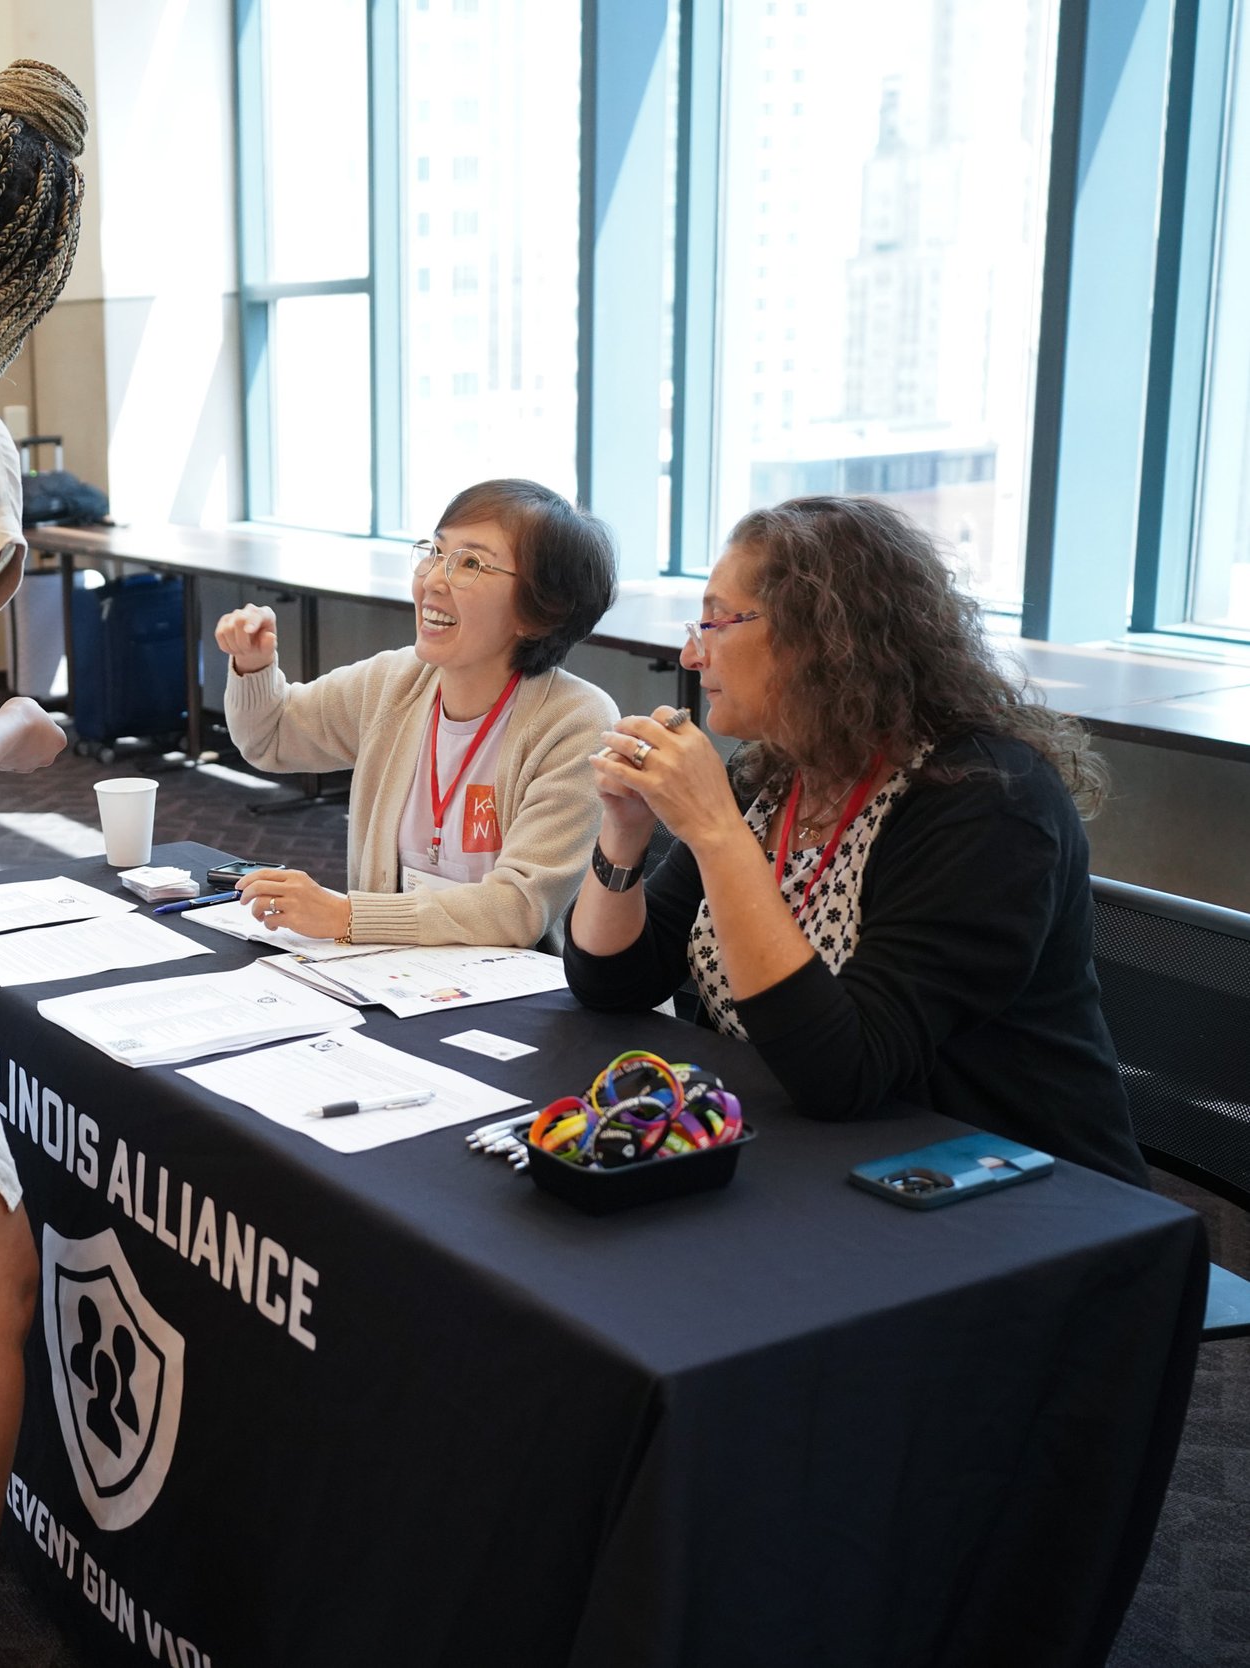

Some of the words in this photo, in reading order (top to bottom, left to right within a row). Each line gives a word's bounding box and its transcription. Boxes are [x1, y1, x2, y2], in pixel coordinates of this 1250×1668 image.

[106, 1138, 320, 1351] ALLIANCE
[6, 1471, 80, 1580] EVENT
[83, 1552, 136, 1644] GUN
